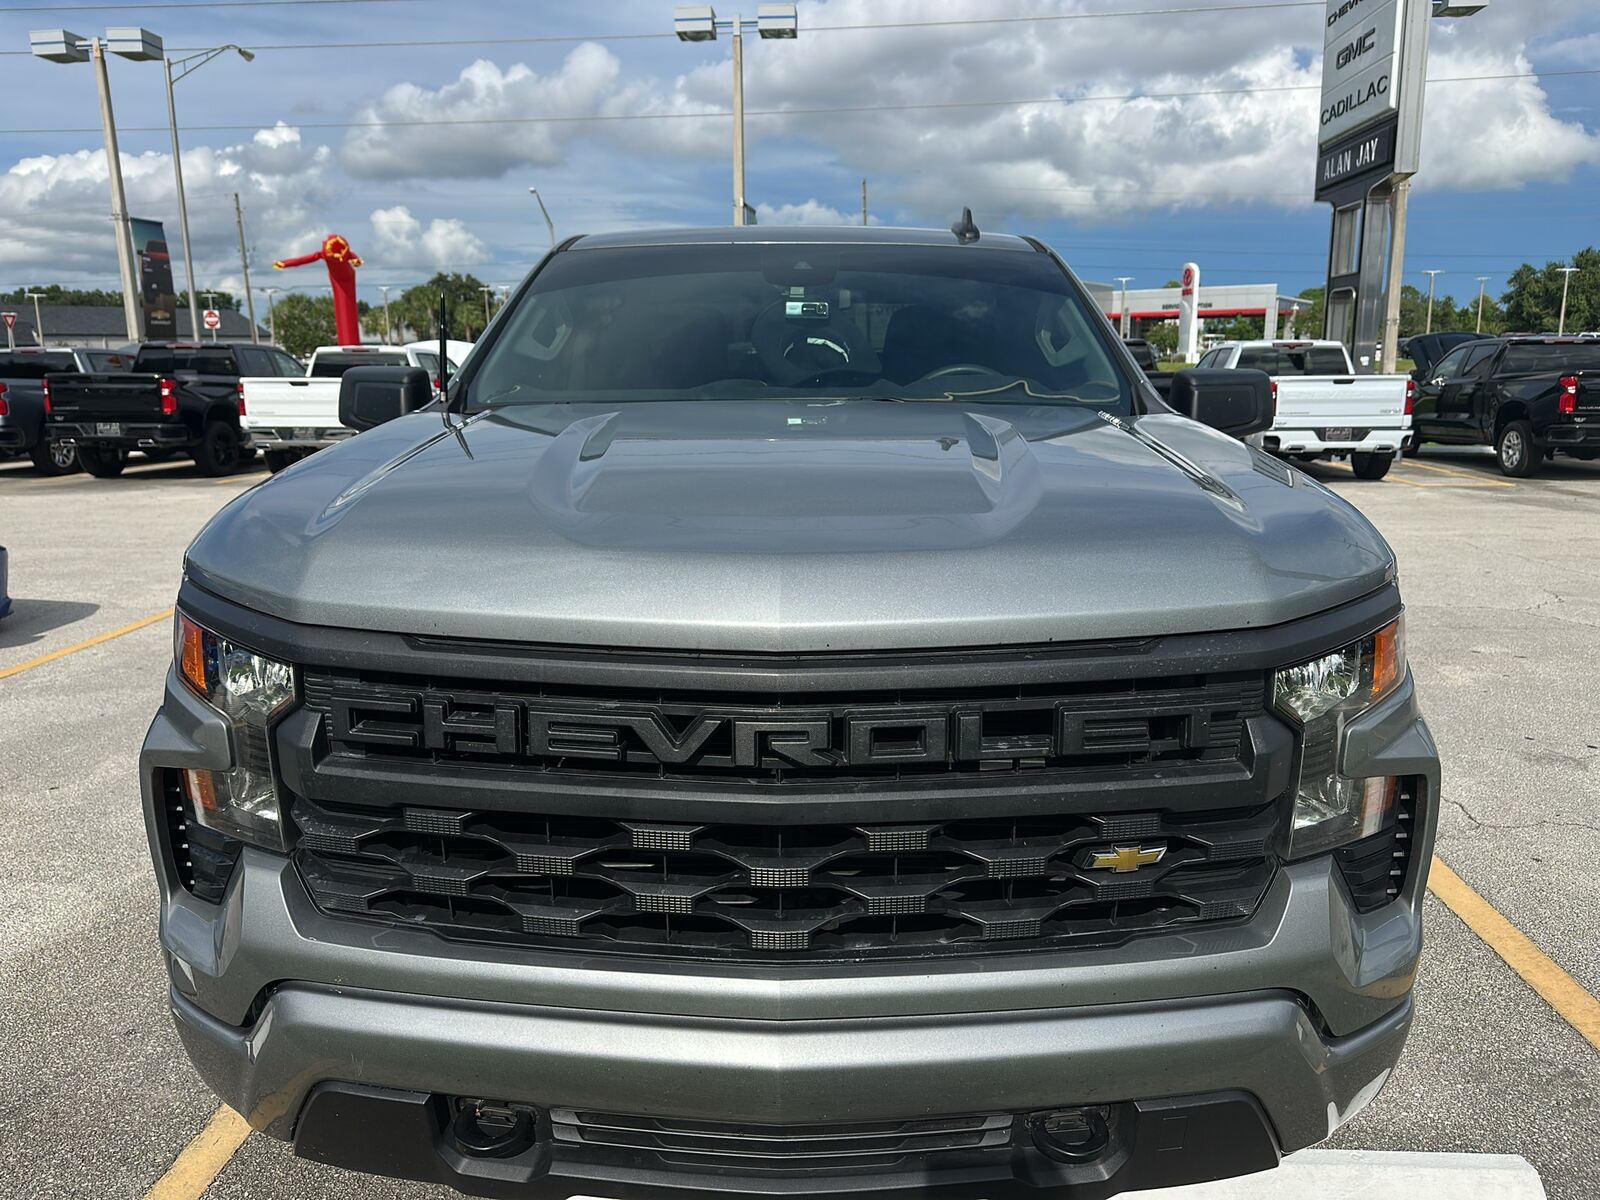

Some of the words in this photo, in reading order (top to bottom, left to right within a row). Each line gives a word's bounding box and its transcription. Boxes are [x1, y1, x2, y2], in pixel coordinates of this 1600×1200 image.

[1336, 27, 1376, 71] GMC
[1320, 74, 1389, 126] CADILLAC
[1323, 149, 1352, 181] ALAN
[1355, 137, 1379, 168] JAY
[331, 695, 1240, 769] CHEVROLET
